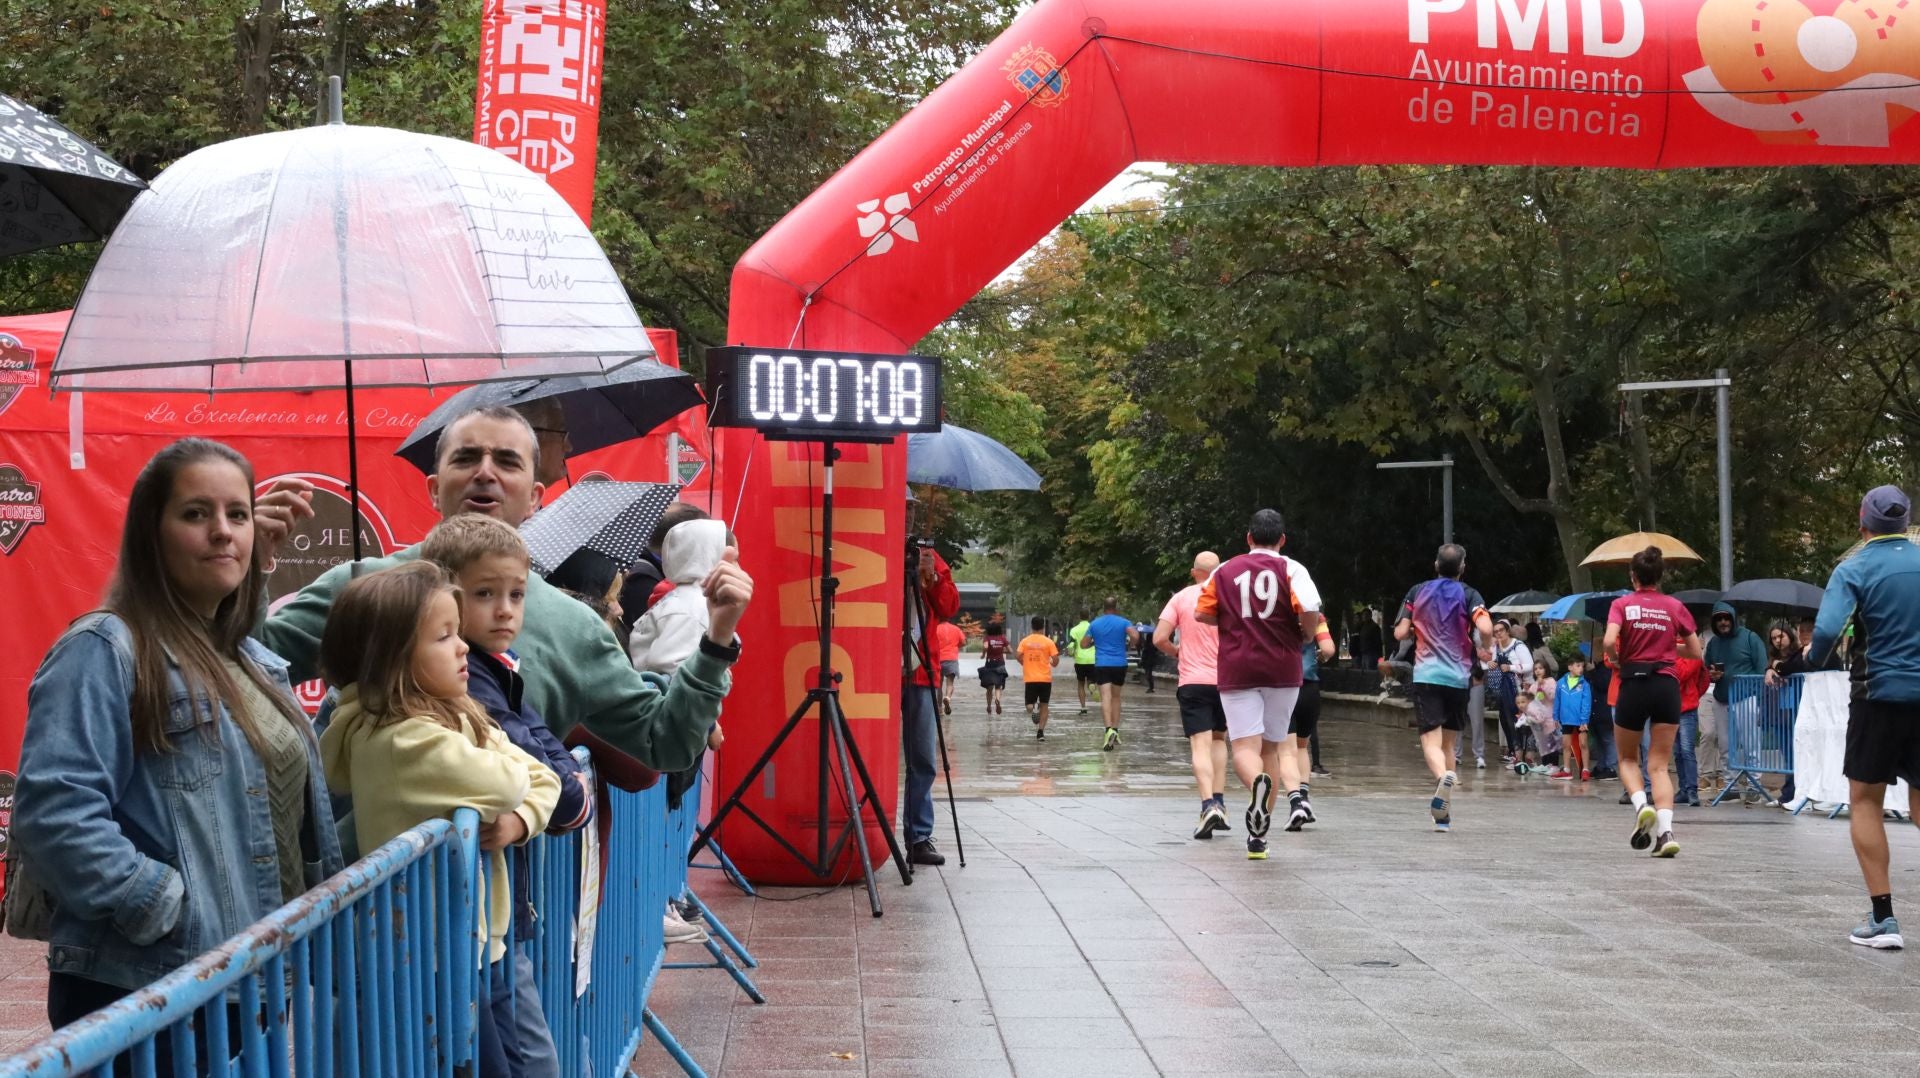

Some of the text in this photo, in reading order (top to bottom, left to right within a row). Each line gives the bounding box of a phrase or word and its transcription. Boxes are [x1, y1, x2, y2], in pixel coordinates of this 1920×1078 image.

[1408, 0, 1645, 58] PMD
[1409, 48, 1643, 99] Ayuntamiento
[1408, 88, 1641, 137] de Palencia
[521, 109, 549, 182] LE
[550, 112, 577, 174] PA
[912, 99, 1013, 194] Patronato Municipal
[934, 121, 1033, 216] Ayuntamiento de Palencia
[943, 129, 1005, 188] de Deportes
[524, 248, 575, 290] love
[144, 402, 178, 424] La
[185, 402, 298, 425] Excelencia
[305, 413, 328, 424] en
[750, 354, 922, 426] 00:07:08
[1233, 569, 1279, 620] 19
